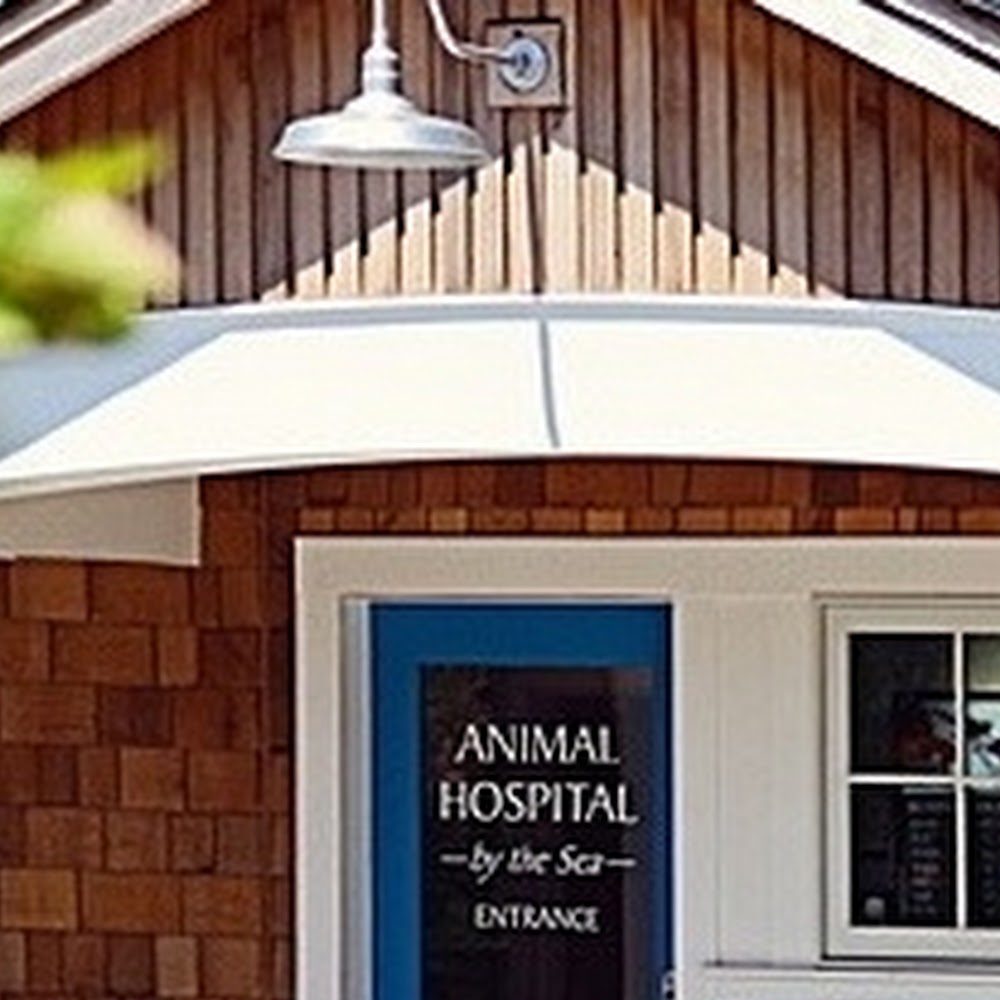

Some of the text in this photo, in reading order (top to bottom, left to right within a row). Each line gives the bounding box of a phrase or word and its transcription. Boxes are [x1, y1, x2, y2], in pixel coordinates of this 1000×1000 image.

[454, 724, 619, 764] ANIMAL
[439, 780, 640, 824] HOSPITAL
[469, 841, 604, 885] by the Sea
[473, 903, 600, 933] ENTRANCE
